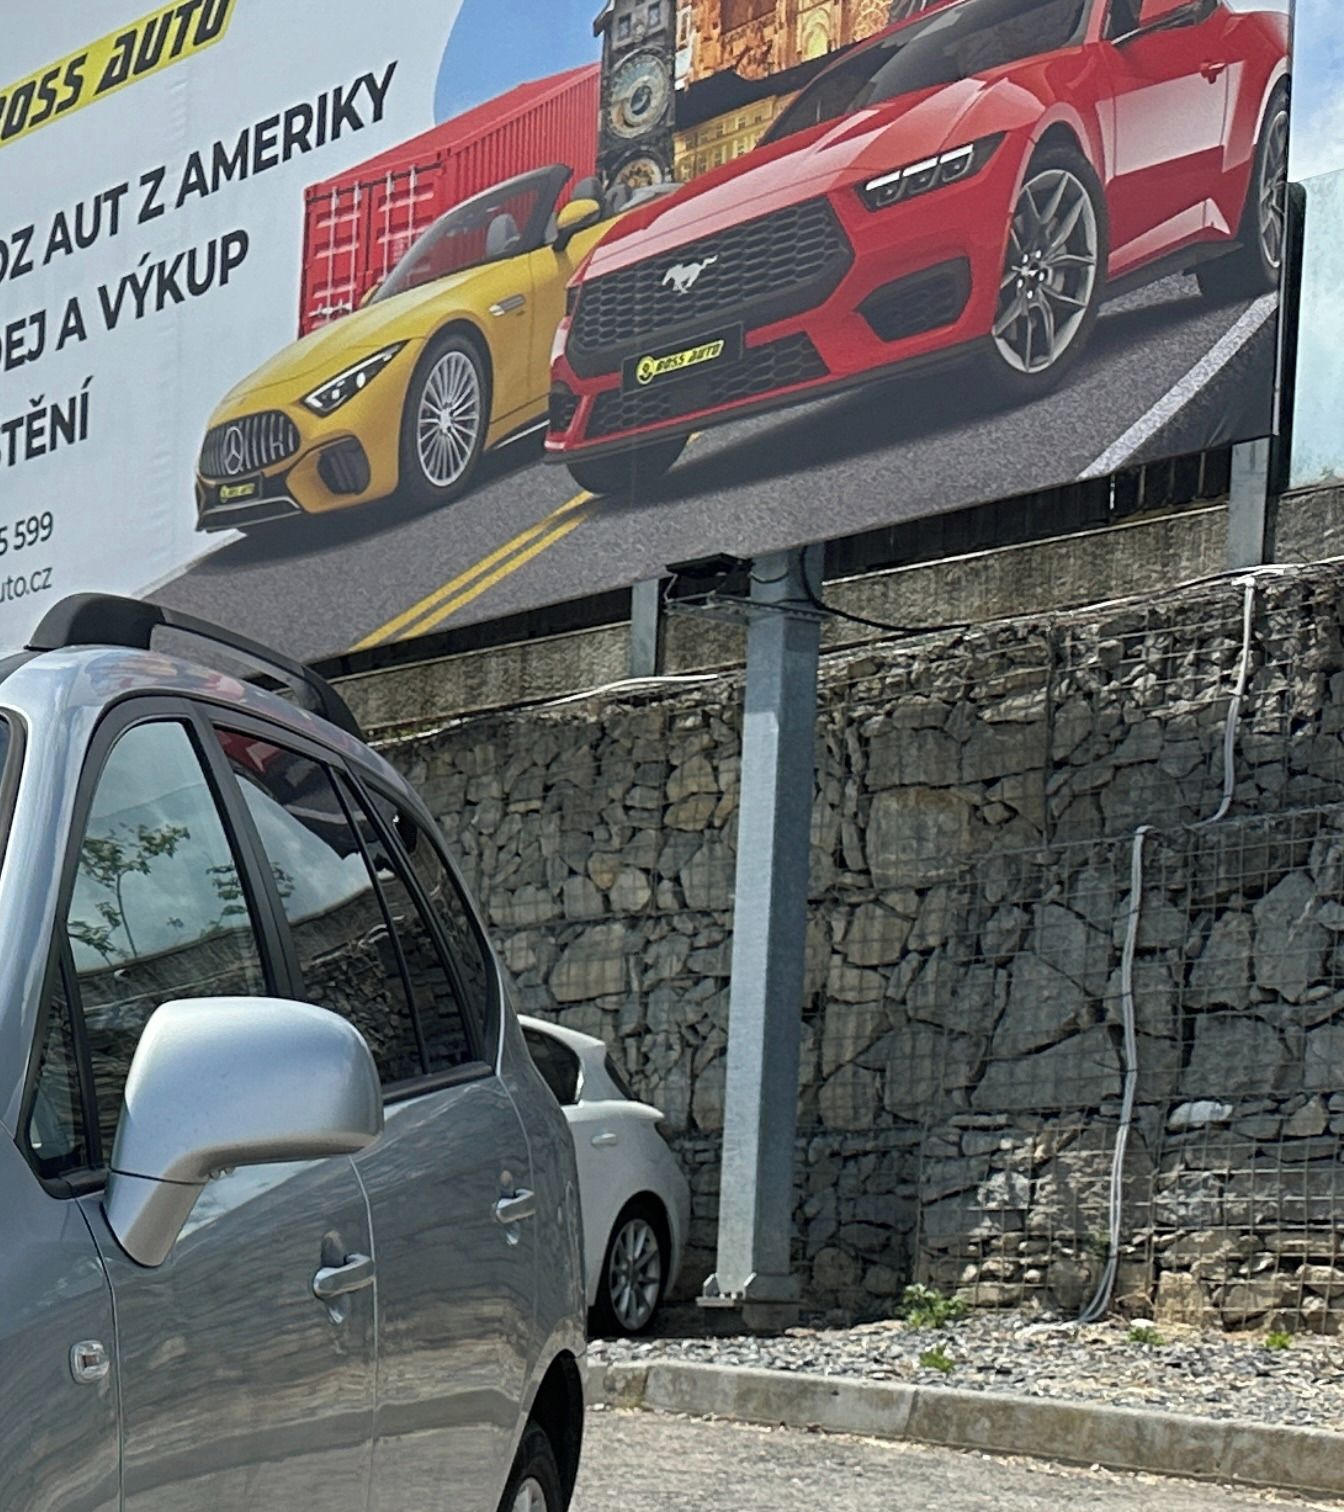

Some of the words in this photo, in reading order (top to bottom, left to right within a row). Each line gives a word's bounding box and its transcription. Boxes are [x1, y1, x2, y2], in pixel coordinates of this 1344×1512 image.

[94, 0, 230, 96] AUTO
[43, 182, 129, 266] AUT
[138, 166, 166, 224] Z
[174, 60, 399, 210] AMERIKY
[55, 297, 87, 352] A
[97, 229, 249, 331] VÝKUP
[13, 511, 54, 550] 599
